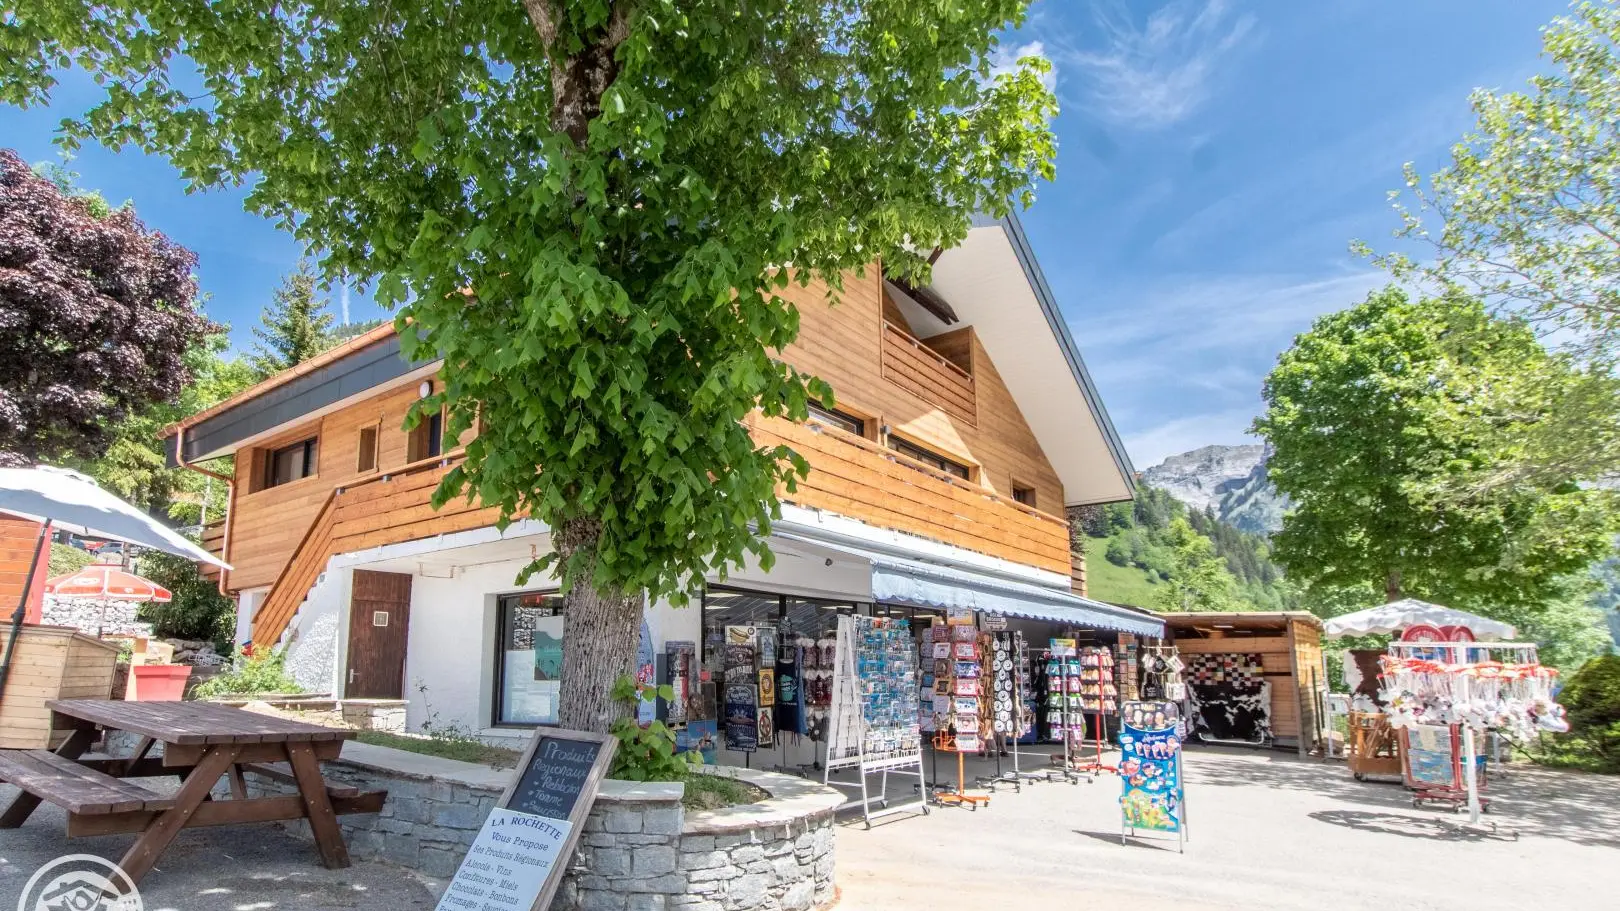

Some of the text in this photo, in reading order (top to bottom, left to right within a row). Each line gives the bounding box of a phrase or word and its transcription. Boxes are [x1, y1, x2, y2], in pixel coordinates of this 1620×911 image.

[544, 741, 595, 763] Produits
[491, 817, 563, 840] LA ROCHETTE
[492, 832, 549, 851] Vous Propose
[485, 847, 513, 861] Produits
[465, 860, 490, 871] Alcools
[496, 865, 512, 876] Vins
[459, 870, 494, 886] Confitures
[499, 879, 519, 891] Miels
[444, 893, 478, 909] Fromages
[452, 881, 484, 896] Chocolats
[489, 890, 519, 905] Bonbons
